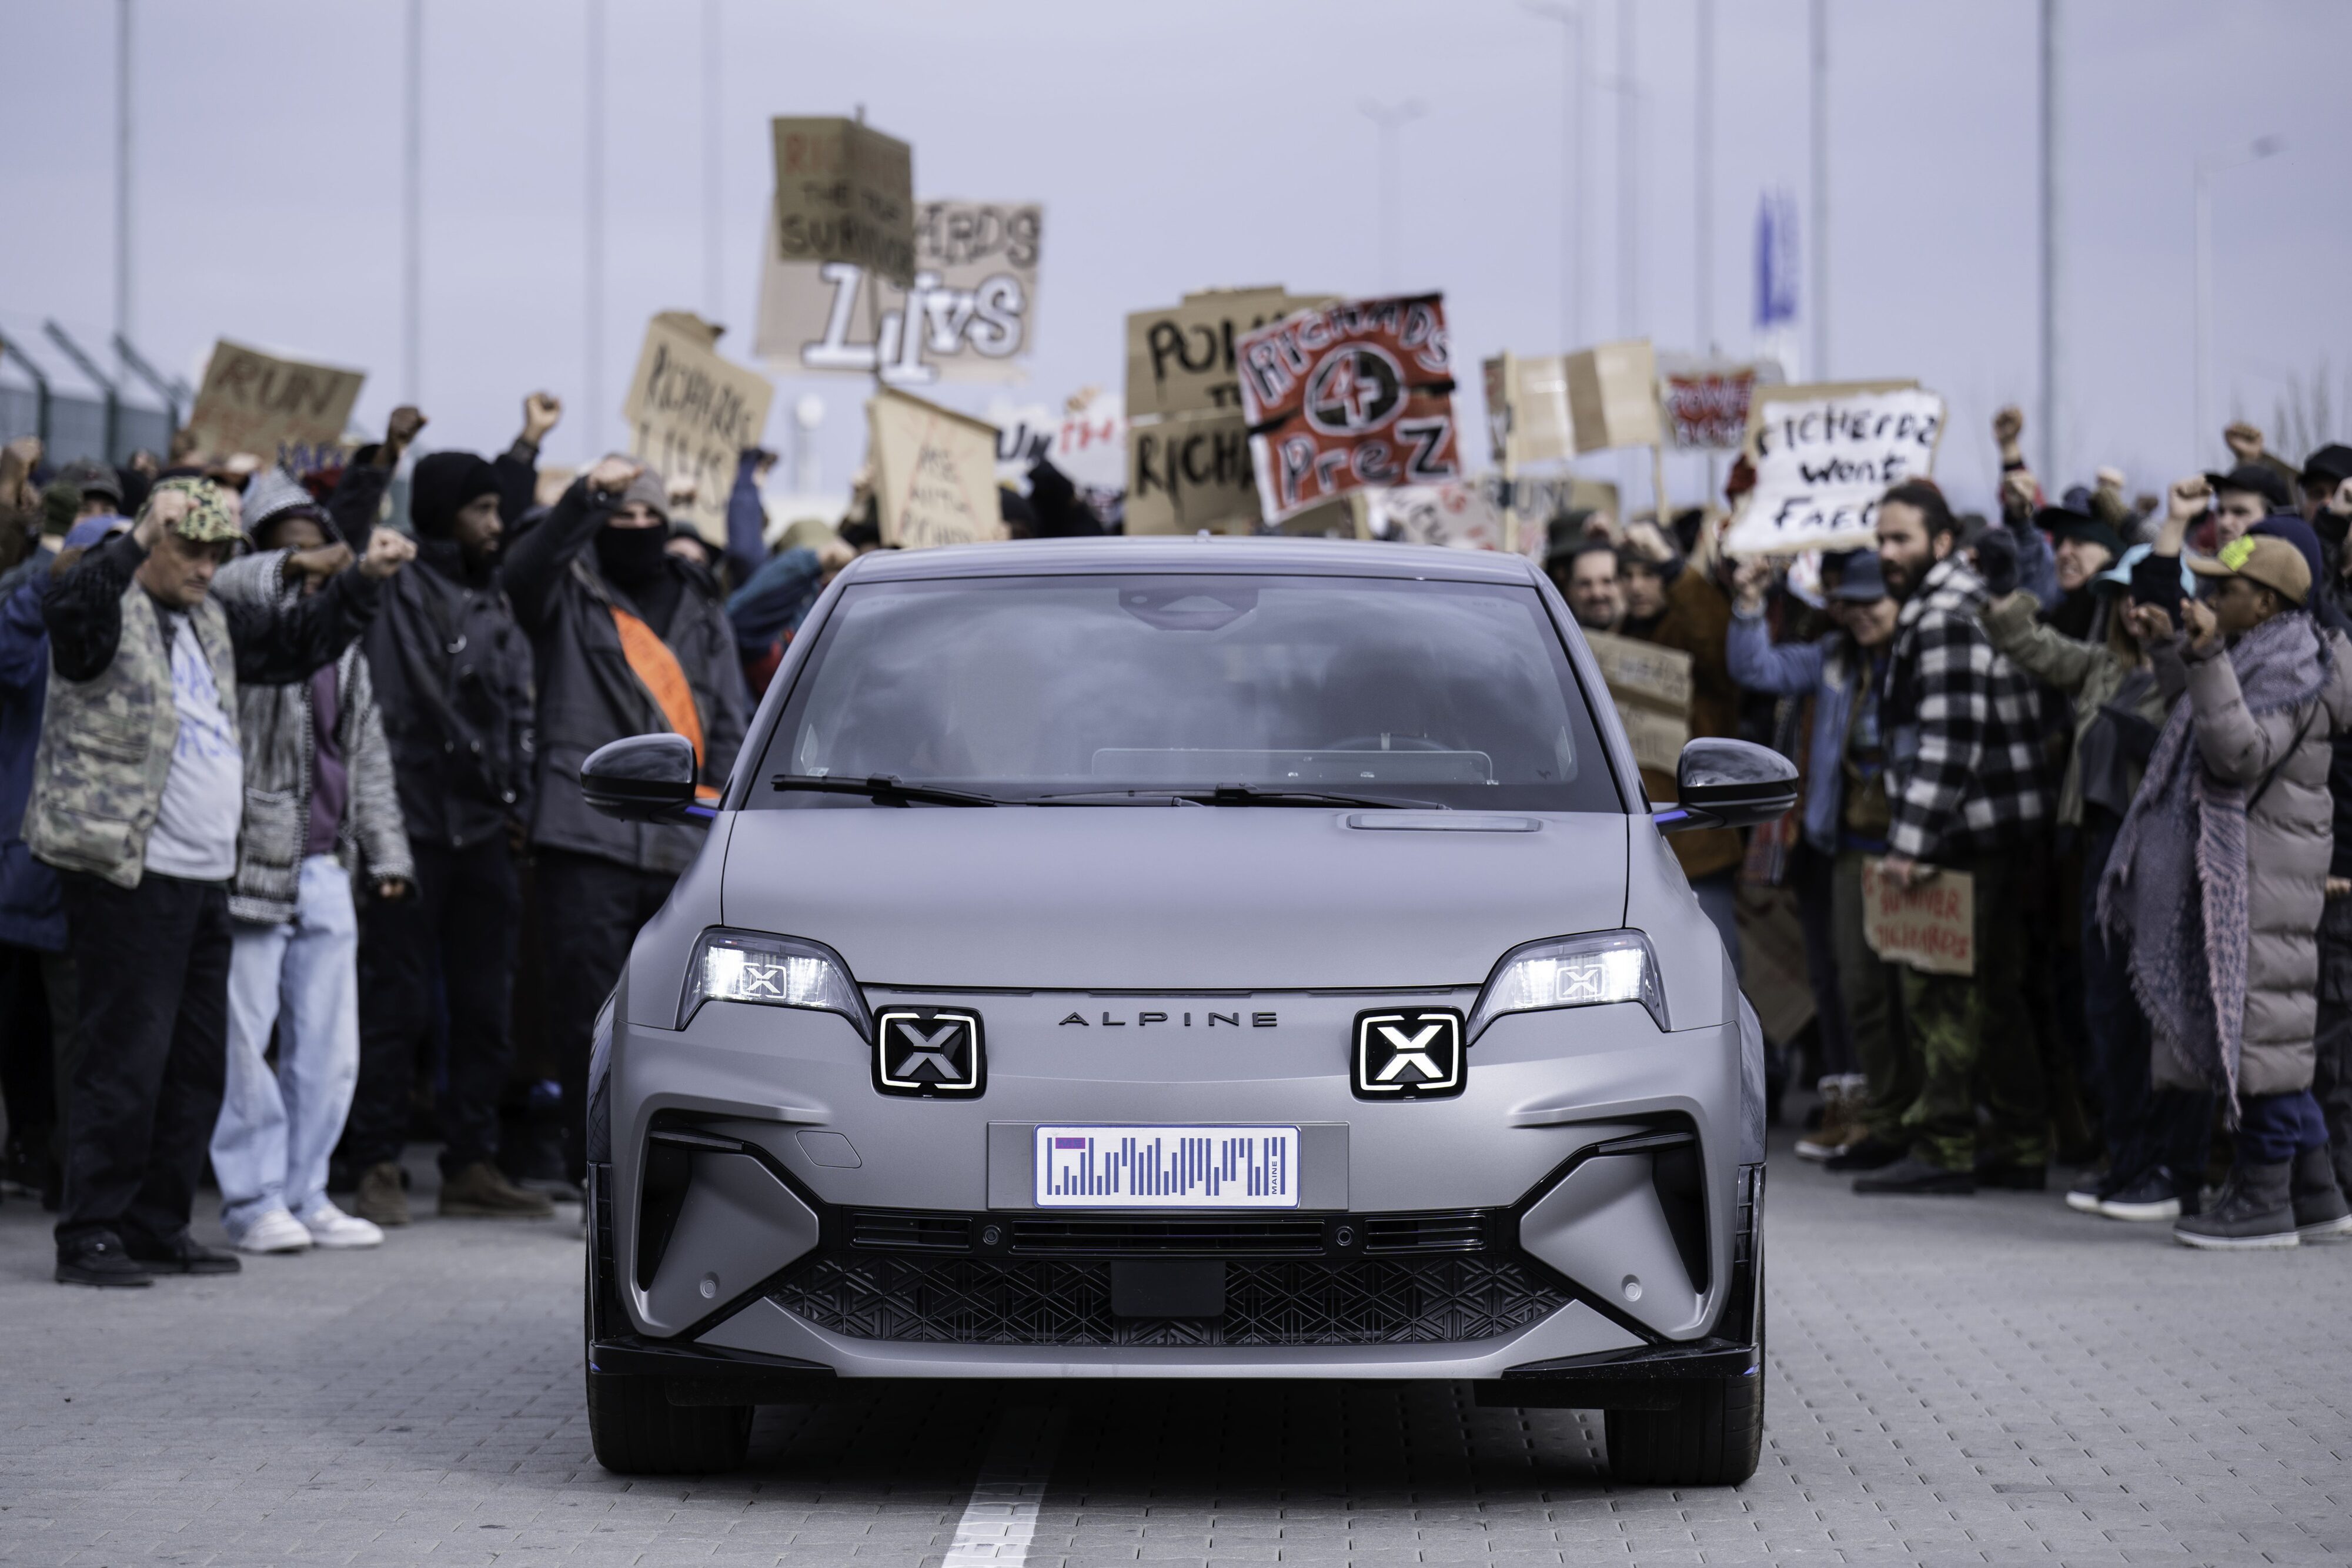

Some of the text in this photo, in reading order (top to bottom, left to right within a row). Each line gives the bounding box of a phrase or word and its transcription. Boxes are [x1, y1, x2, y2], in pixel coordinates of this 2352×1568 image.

[211, 354, 342, 415] RUN
[1058, 1011, 1278, 1027] ALPINE
[1058, 1139, 1084, 1148] ME
